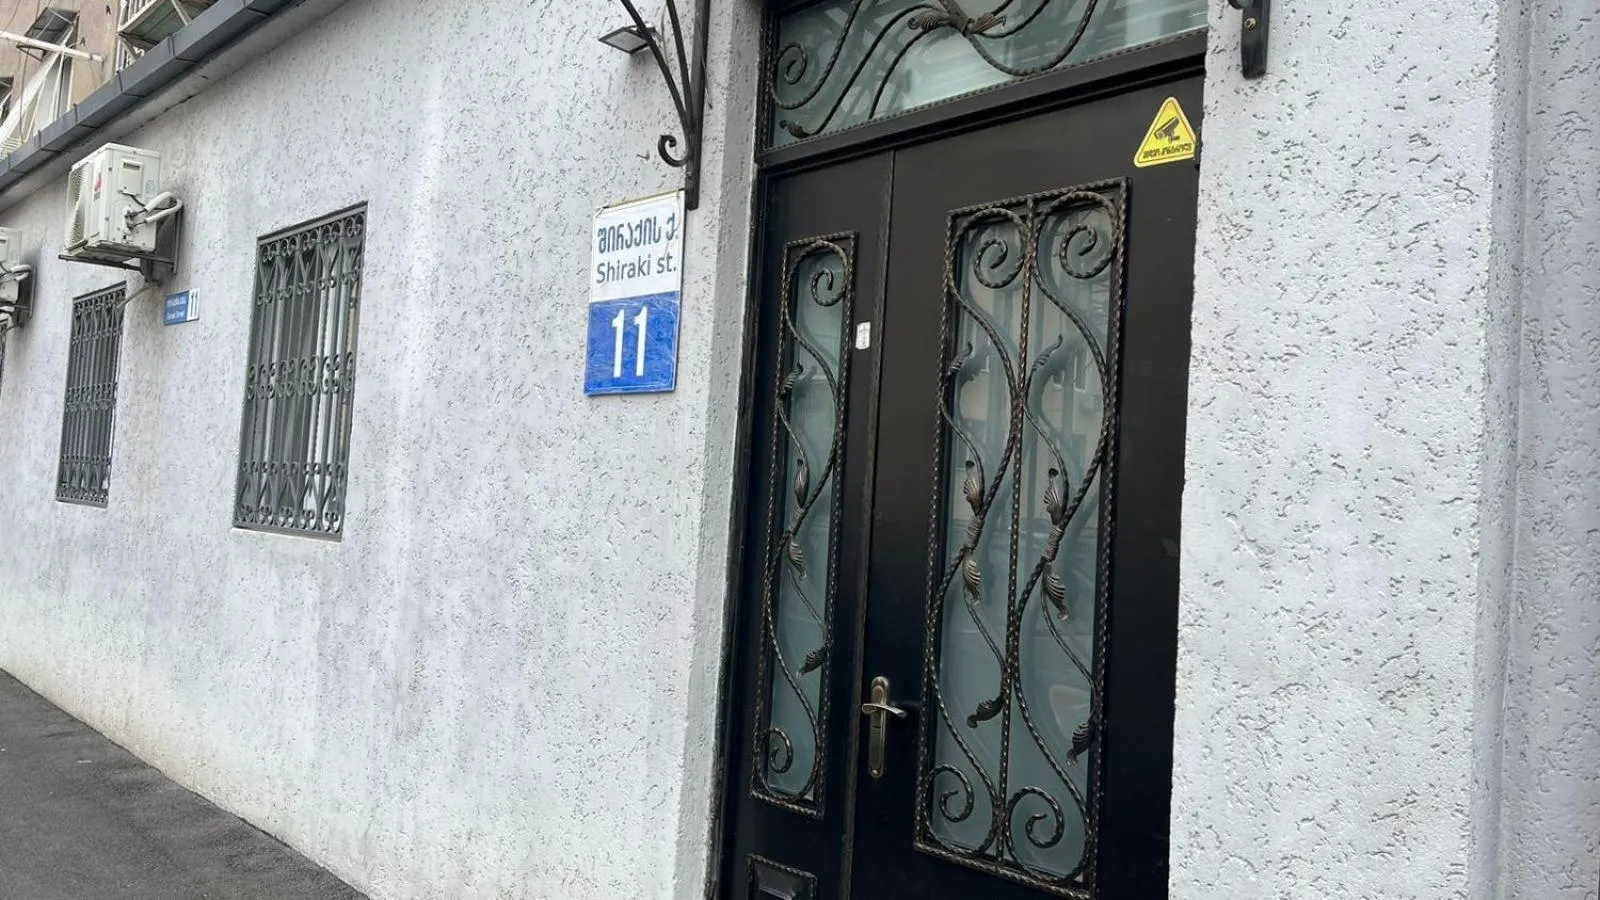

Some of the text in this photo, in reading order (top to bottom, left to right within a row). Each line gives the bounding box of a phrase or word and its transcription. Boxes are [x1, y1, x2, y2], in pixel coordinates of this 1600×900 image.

[597, 216, 662, 254] შირაქის
[596, 251, 677, 284] Shiraki st.
[611, 306, 648, 378] 11
